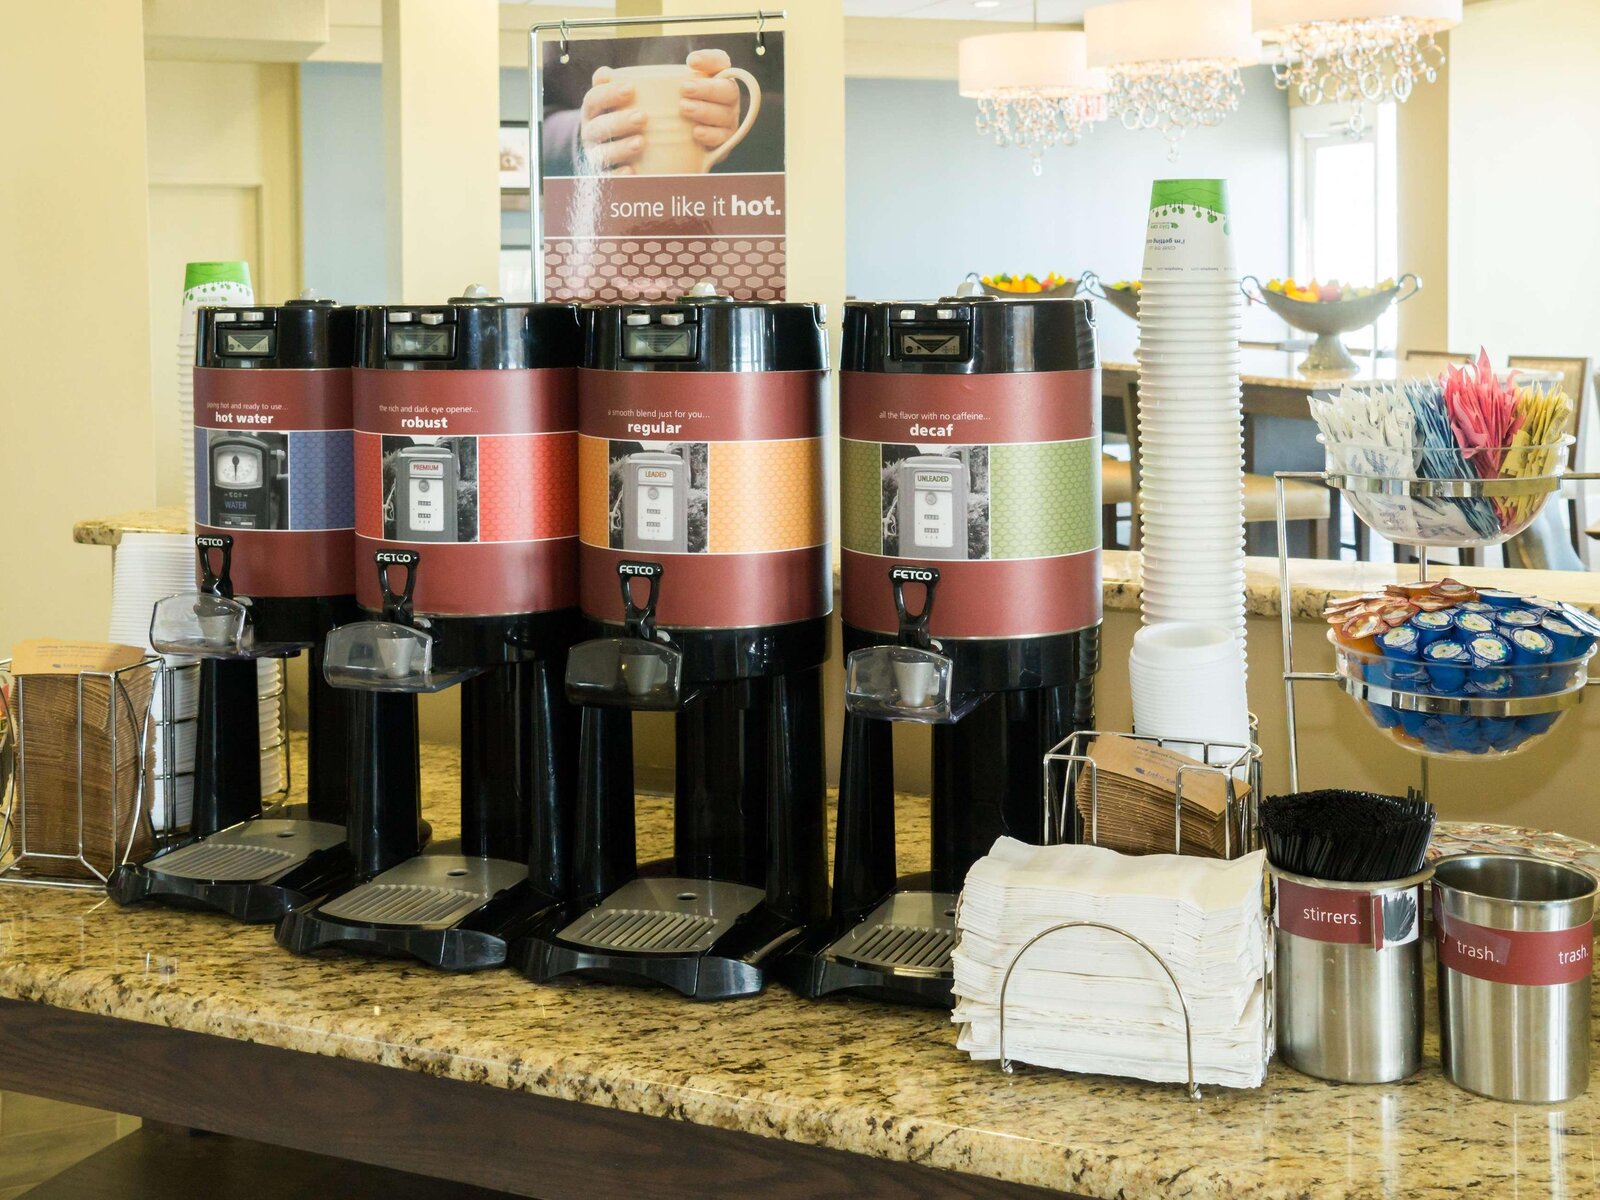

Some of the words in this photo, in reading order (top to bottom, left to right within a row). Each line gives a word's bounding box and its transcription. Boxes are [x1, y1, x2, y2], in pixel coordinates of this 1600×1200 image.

[610, 201, 664, 218] some
[671, 195, 706, 217] like
[713, 195, 726, 217] it
[731, 194, 782, 216] hot.
[243, 403, 260, 411] ready
[379, 404, 387, 412] the
[400, 405, 412, 413] and
[414, 405, 429, 413] dark
[215, 411, 233, 422] hot
[236, 414, 274, 424] water
[612, 409, 634, 417] smooth
[636, 409, 656, 418] blend
[658, 410, 672, 419] just
[675, 410, 685, 418] for
[688, 411, 710, 419] you...
[888, 411, 898, 419] the
[900, 411, 919, 420] flavor
[920, 412, 937, 420] with
[401, 416, 448, 428] robust
[627, 421, 682, 436] regular
[910, 423, 954, 437] decaf
[224, 501, 247, 509] WATER
[197, 538, 223, 546] FETCO
[377, 553, 411, 562] FETCO
[619, 565, 654, 575] FETCO
[893, 569, 932, 580] FETCO
[1303, 907, 1362, 925] stirrers.
[1456, 940, 1500, 963] trash.
[1558, 945, 1589, 964] trash.
